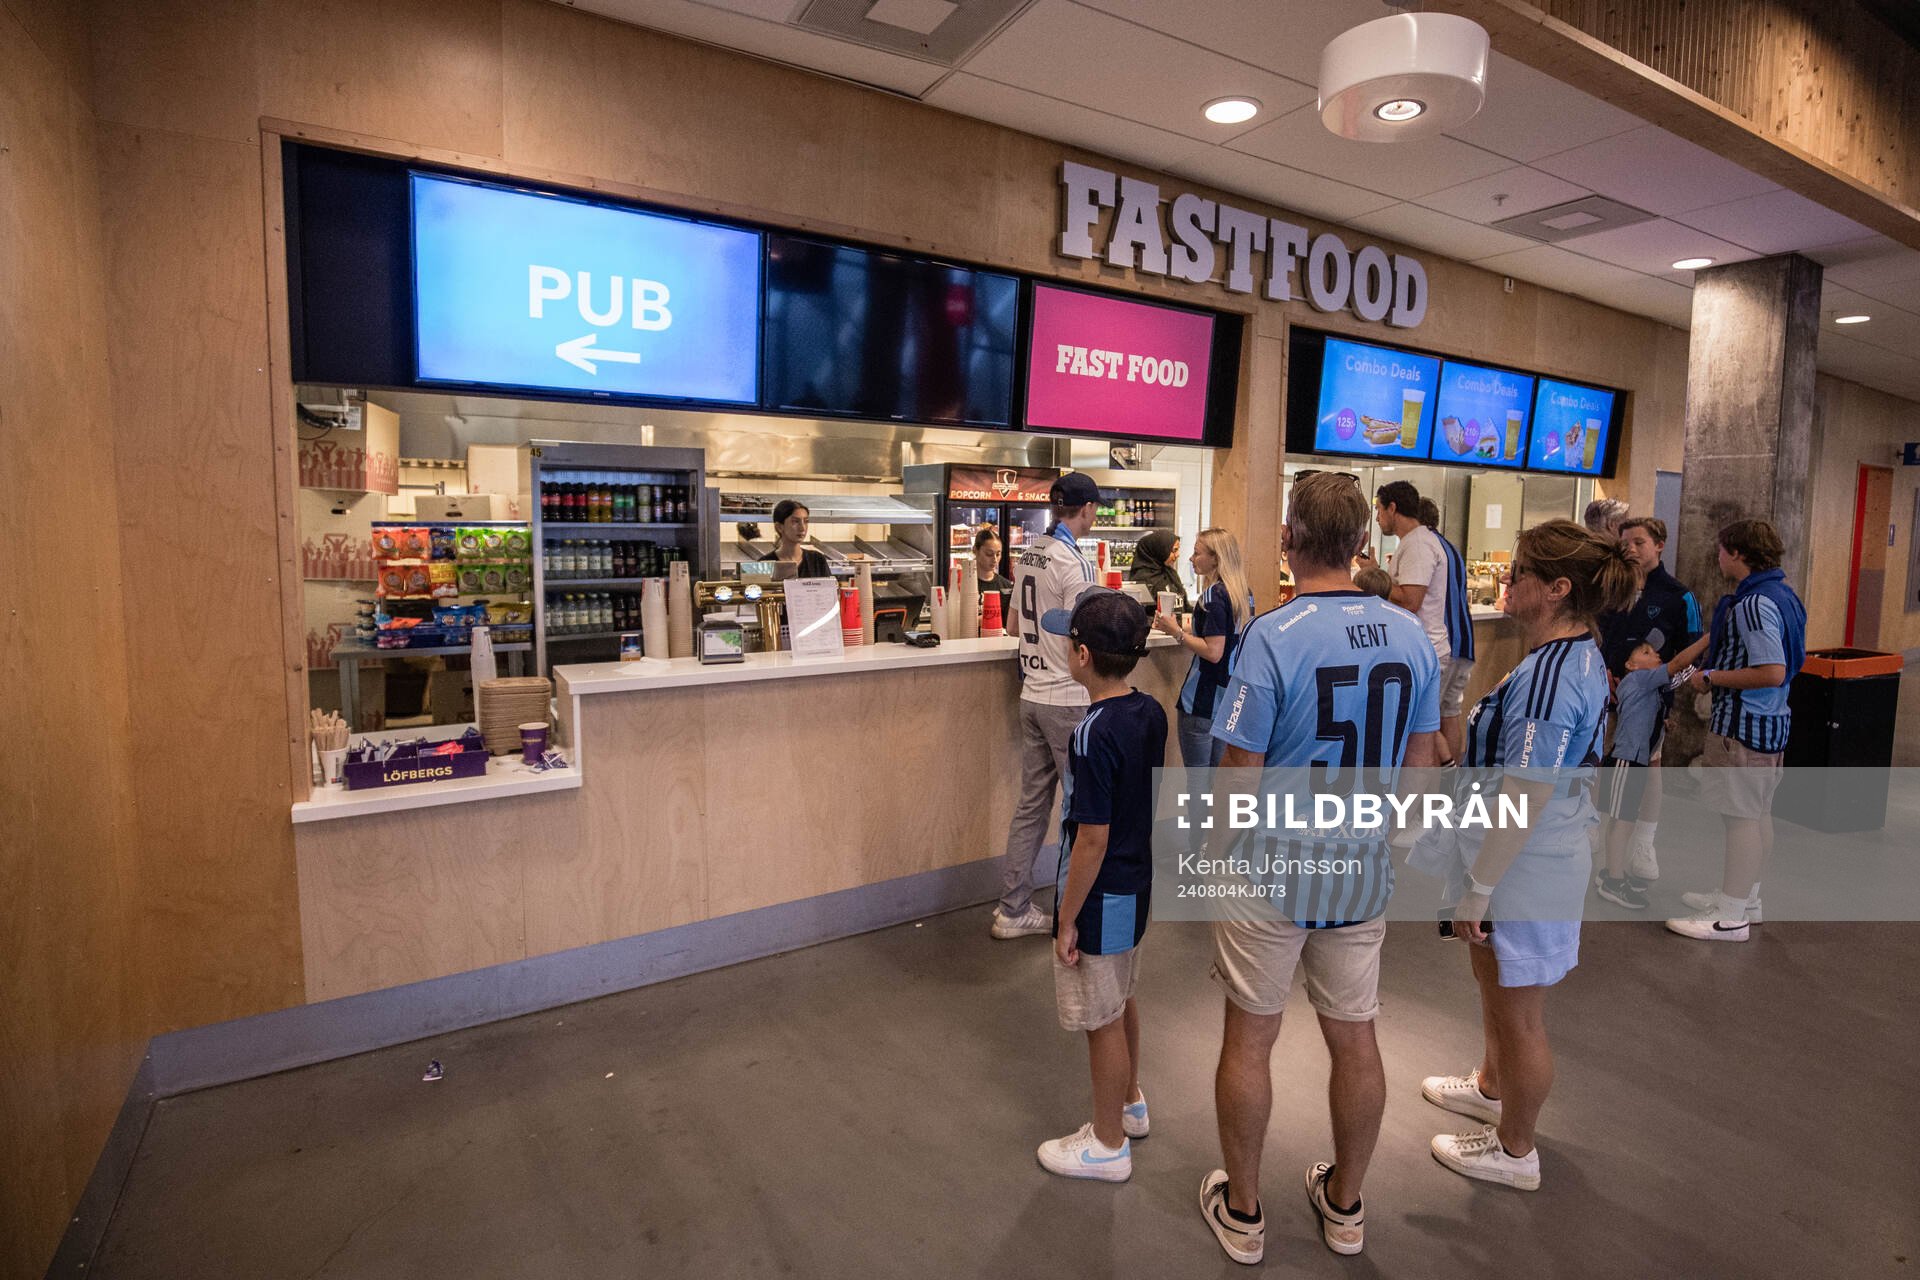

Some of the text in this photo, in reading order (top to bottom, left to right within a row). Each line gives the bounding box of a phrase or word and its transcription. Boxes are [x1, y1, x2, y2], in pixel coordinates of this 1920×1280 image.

[1060, 160, 1428, 329] FASTFOOD
[528, 264, 673, 331] PUB
[1056, 344, 1189, 387] FAST FOOD
[1345, 355, 1421, 382] Combo Deals
[1457, 374, 1518, 398] Combo Deals
[1551, 391, 1600, 411] Combo Deals
[530, 447, 542, 458] 45
[950, 489, 992, 500] POPCORN
[1021, 574, 1040, 645] 9
[1345, 623, 1389, 650] KENT
[1020, 654, 1048, 670] TCL
[1225, 684, 1248, 733] stadium
[1308, 662, 1413, 801] 50
[1520, 721, 1537, 769] stadium
[1552, 729, 1571, 775] stadium
[383, 766, 453, 782] LÖFBERGS
